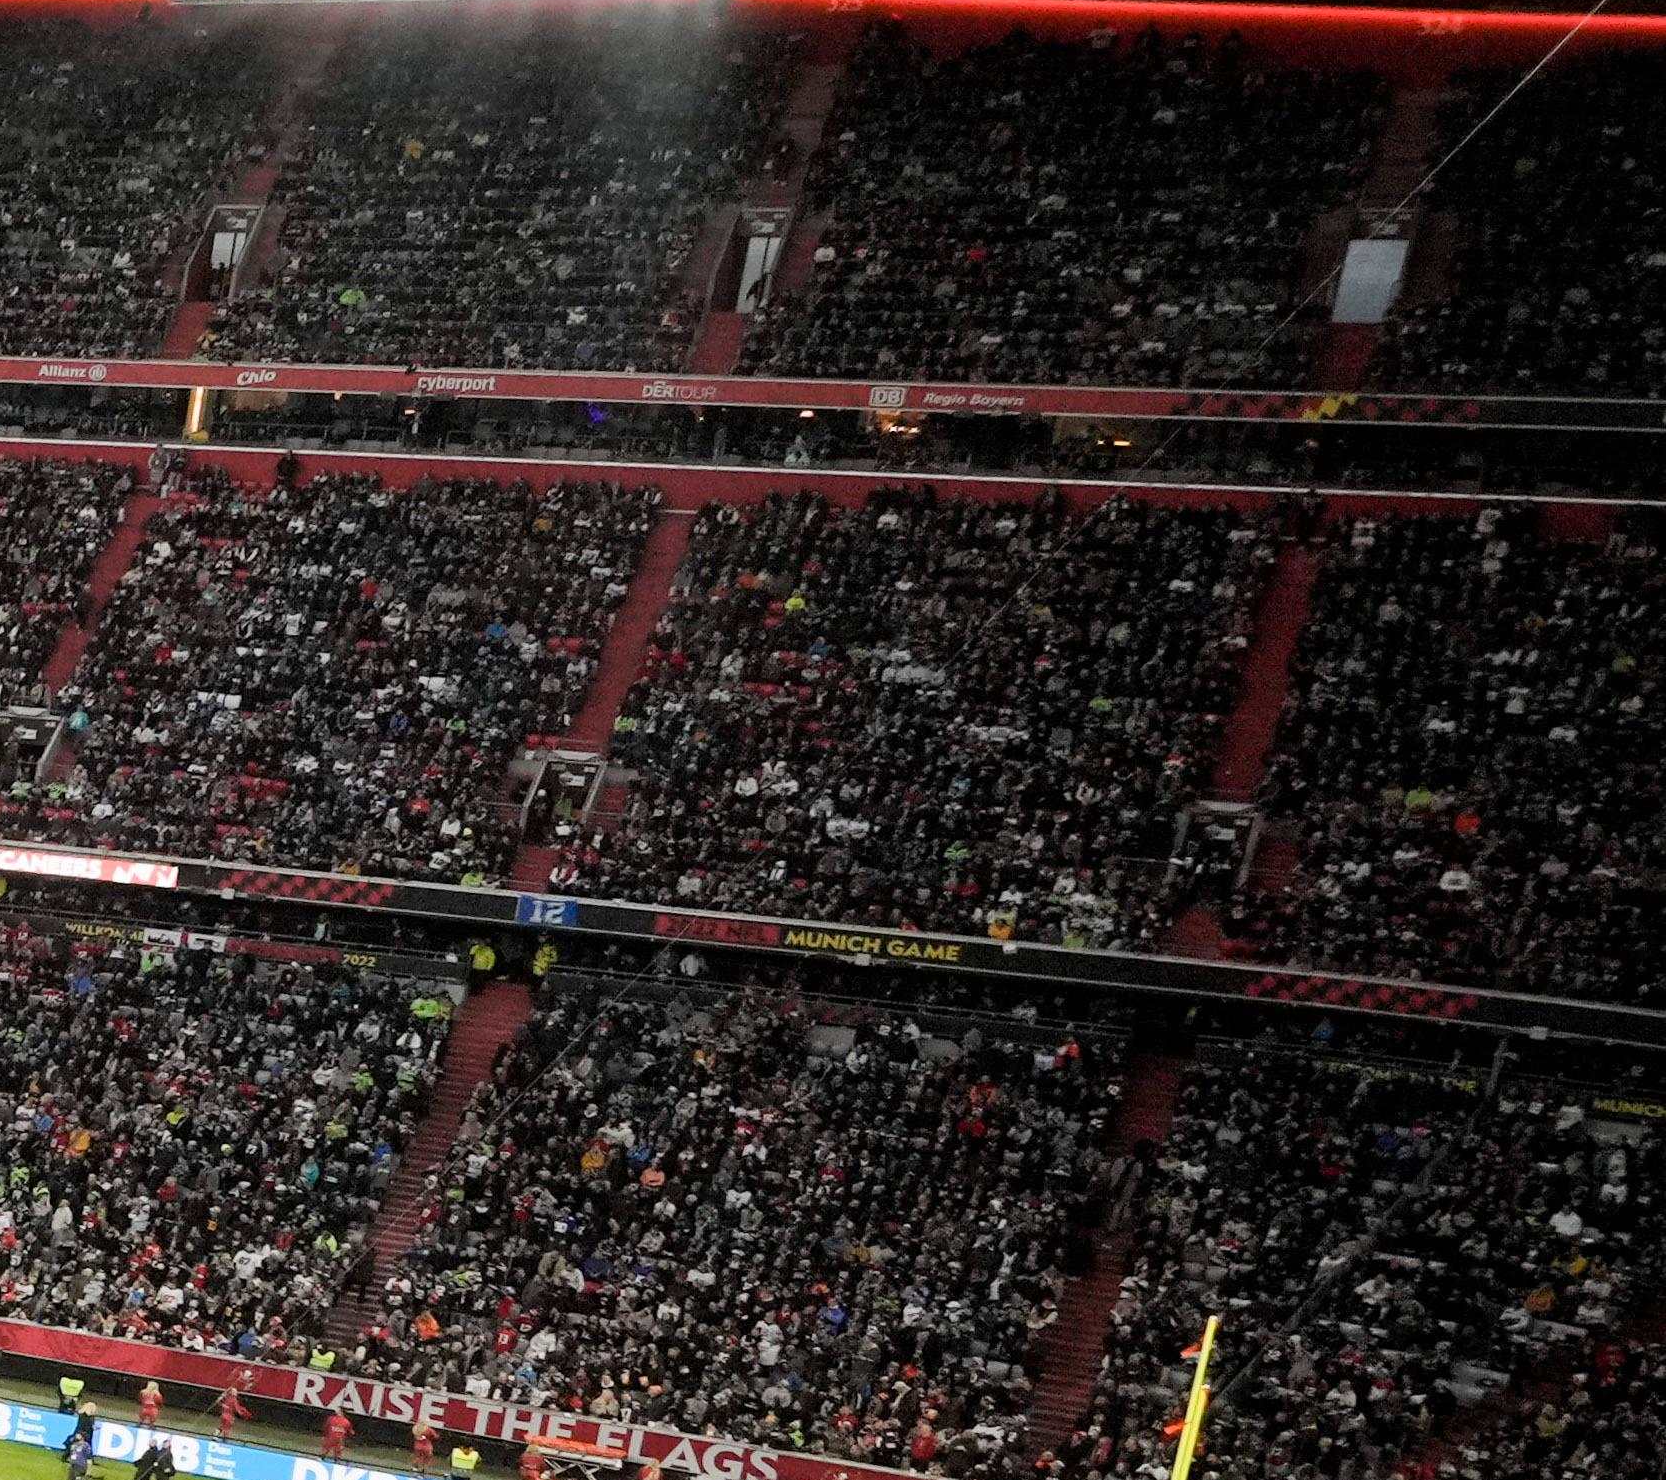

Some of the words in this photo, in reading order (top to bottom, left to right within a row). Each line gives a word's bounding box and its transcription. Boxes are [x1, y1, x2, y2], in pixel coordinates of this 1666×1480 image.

[38, 364, 87, 377] Allianz
[418, 376, 495, 392] cyberport
[642, 381, 716, 399] DERTOUR
[923, 393, 965, 406] Regio
[969, 393, 1025, 407] Bayern
[529, 900, 566, 924] 12
[785, 929, 882, 954] MUNICH
[887, 938, 960, 962] GAME
[342, 953, 376, 968] 2022
[18, 1406, 42, 1422] Das
[295, 1370, 444, 1429] RAISE
[467, 1399, 574, 1443] THE
[98, 1422, 202, 1474] DKB
[207, 1439, 233, 1456] Das
